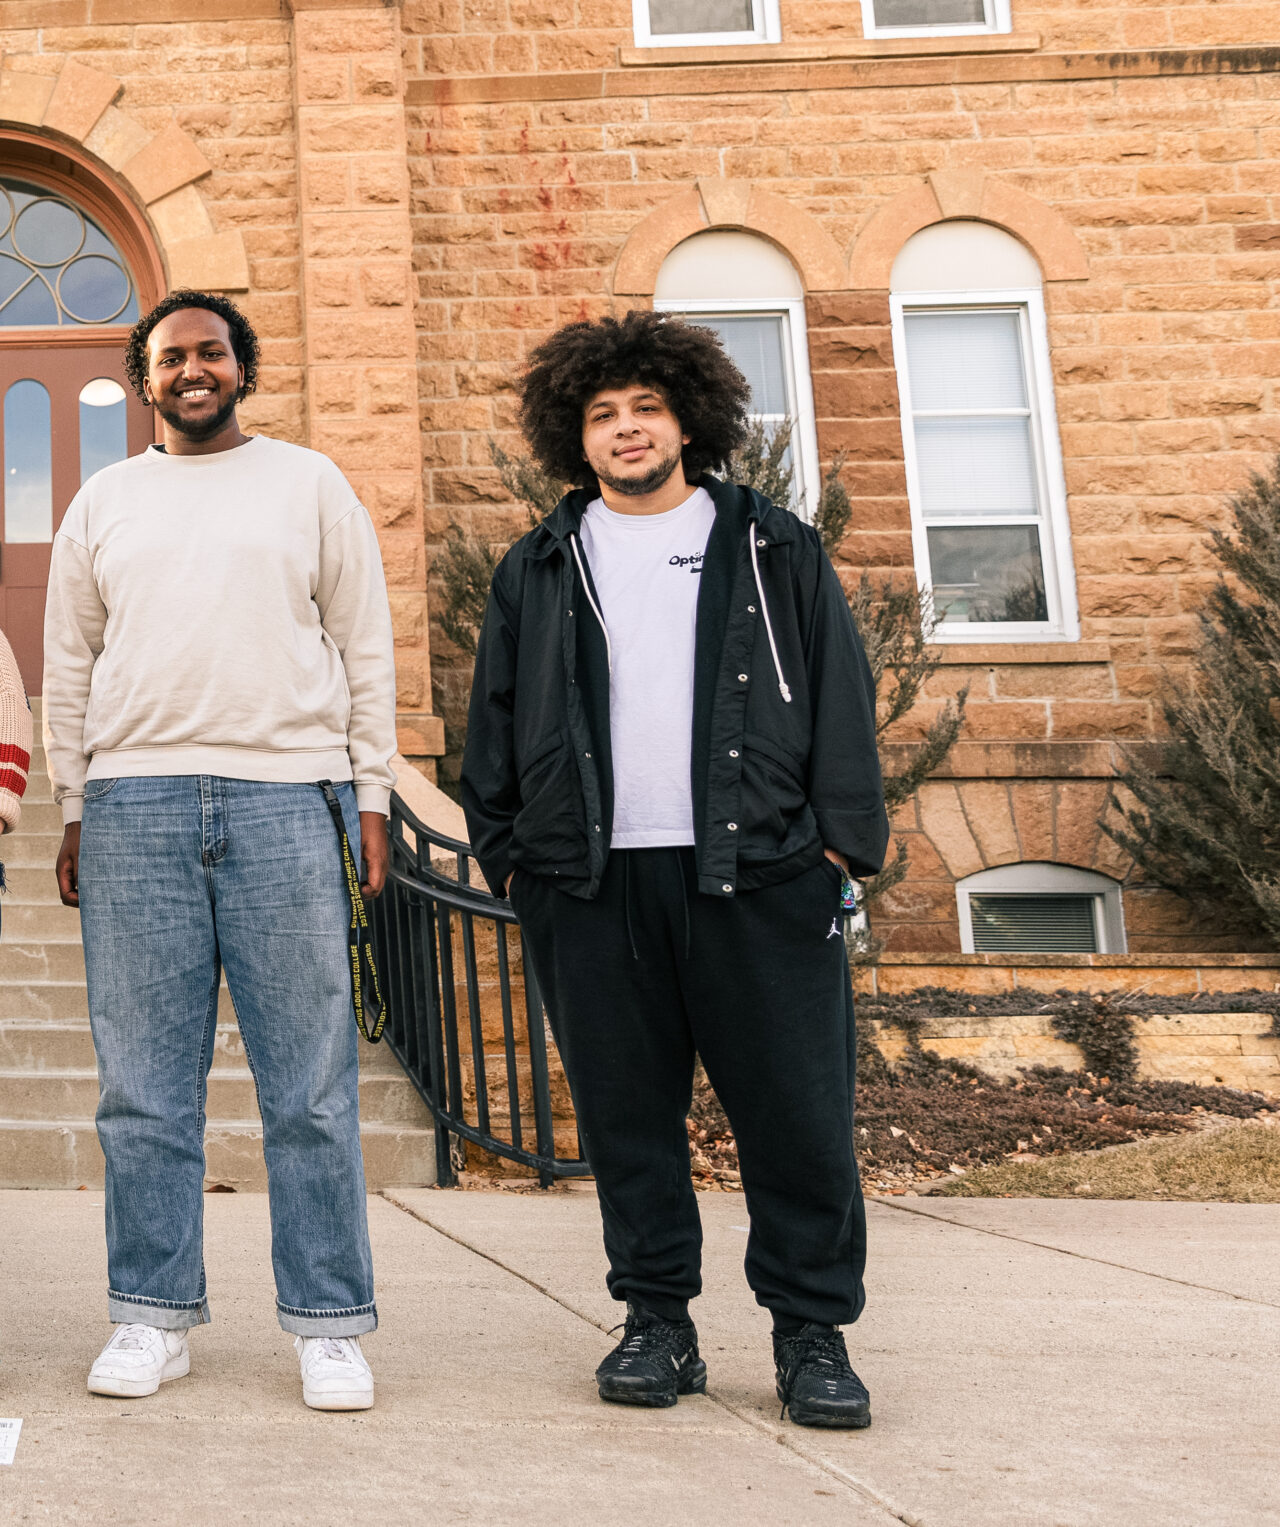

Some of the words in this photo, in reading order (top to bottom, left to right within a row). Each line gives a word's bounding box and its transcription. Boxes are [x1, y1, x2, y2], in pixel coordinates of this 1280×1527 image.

[356, 899, 368, 927] COLLEGE
[350, 944, 360, 973] COLLEGE
[365, 943, 377, 975] GUSTAVUS
[353, 973, 363, 1007] ADOLPHUS
